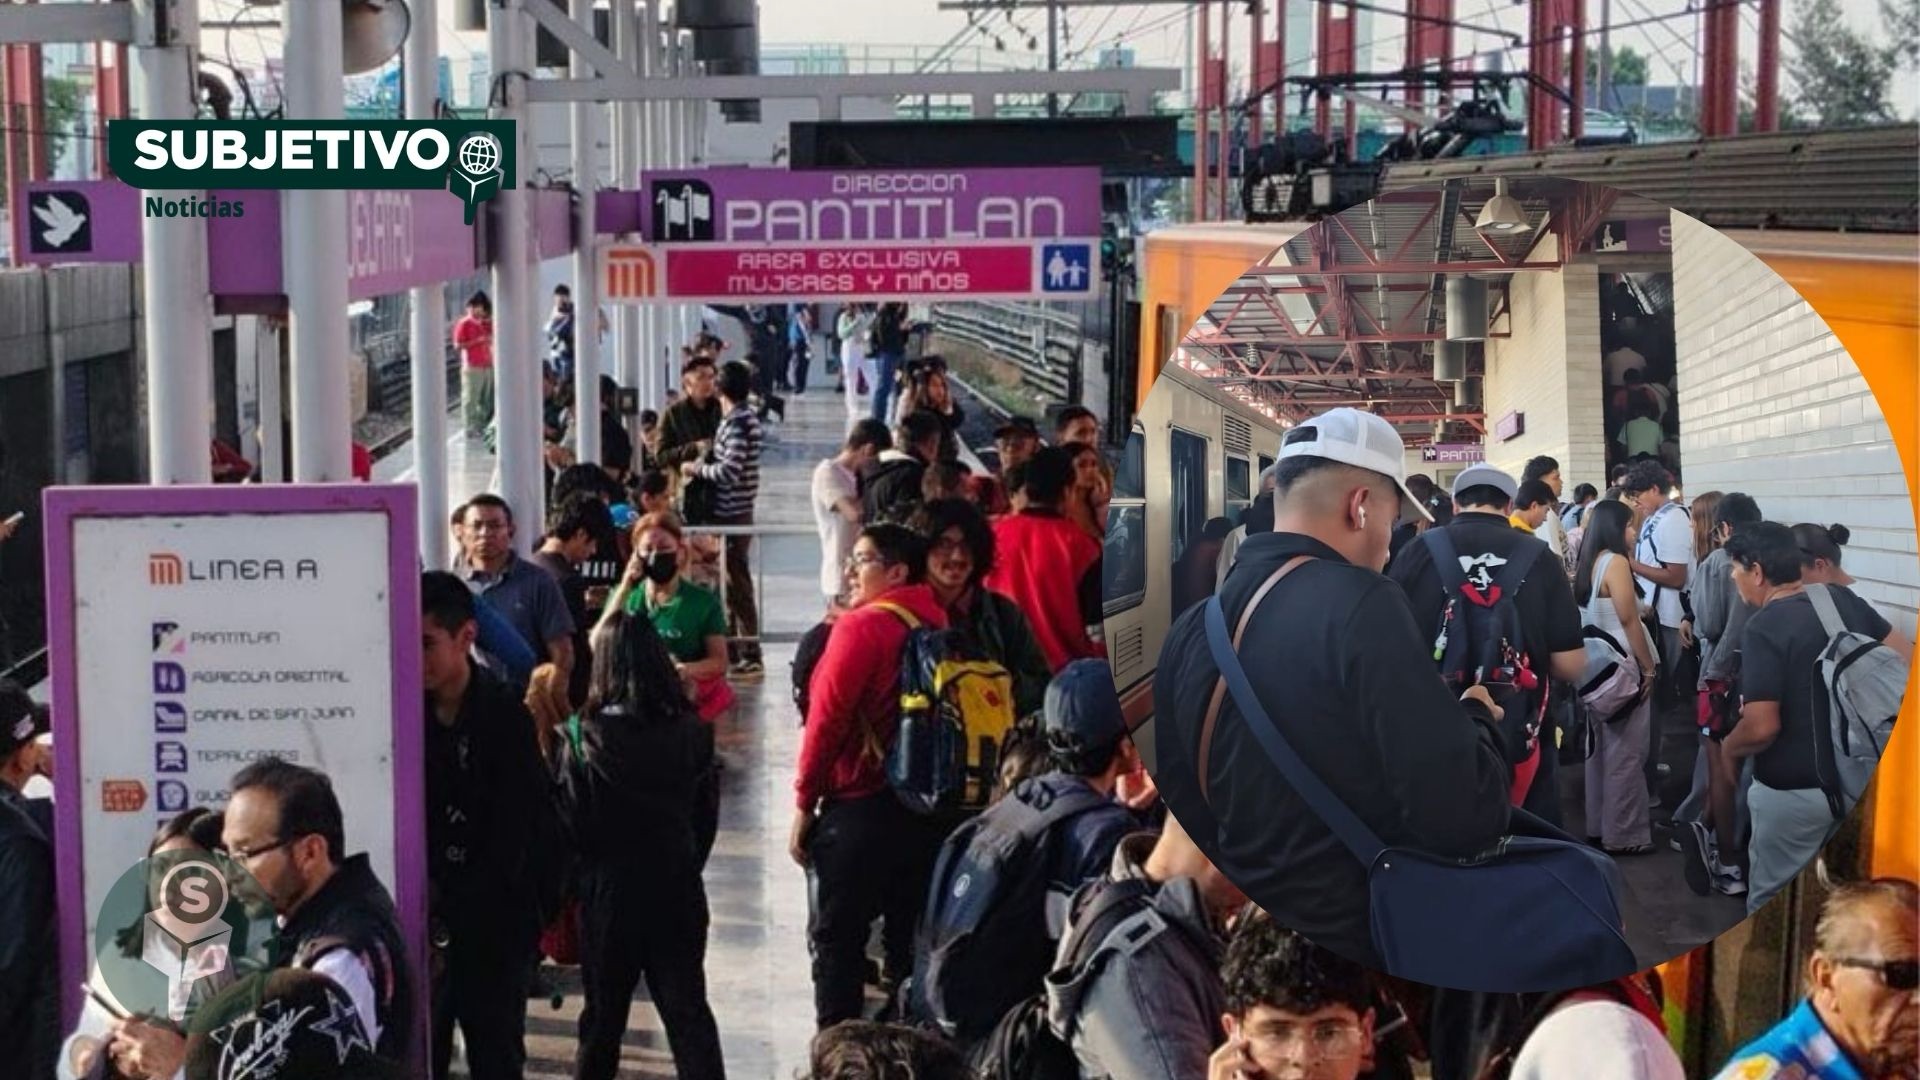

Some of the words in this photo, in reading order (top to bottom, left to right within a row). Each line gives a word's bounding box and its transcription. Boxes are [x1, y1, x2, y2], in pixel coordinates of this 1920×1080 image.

[832, 174, 967, 194] DIRECCION
[725, 197, 1065, 242] PANTITLAN
[737, 251, 806, 270] AREA
[818, 250, 960, 270] EXCLUSIVA
[728, 274, 854, 292] MUJERES
[866, 274, 884, 291] Y
[896, 270, 970, 291] NIÑOS
[189, 559, 285, 581] LINEA
[296, 558, 319, 580] A
[191, 631, 281, 645] PANTITLAN
[191, 670, 271, 684] AGRICOLA
[275, 670, 350, 683] ORIENTAL
[193, 709, 245, 723] CANAL
[248, 708, 272, 722] DE
[274, 706, 308, 721] SAN
[312, 706, 356, 720] JUAN
